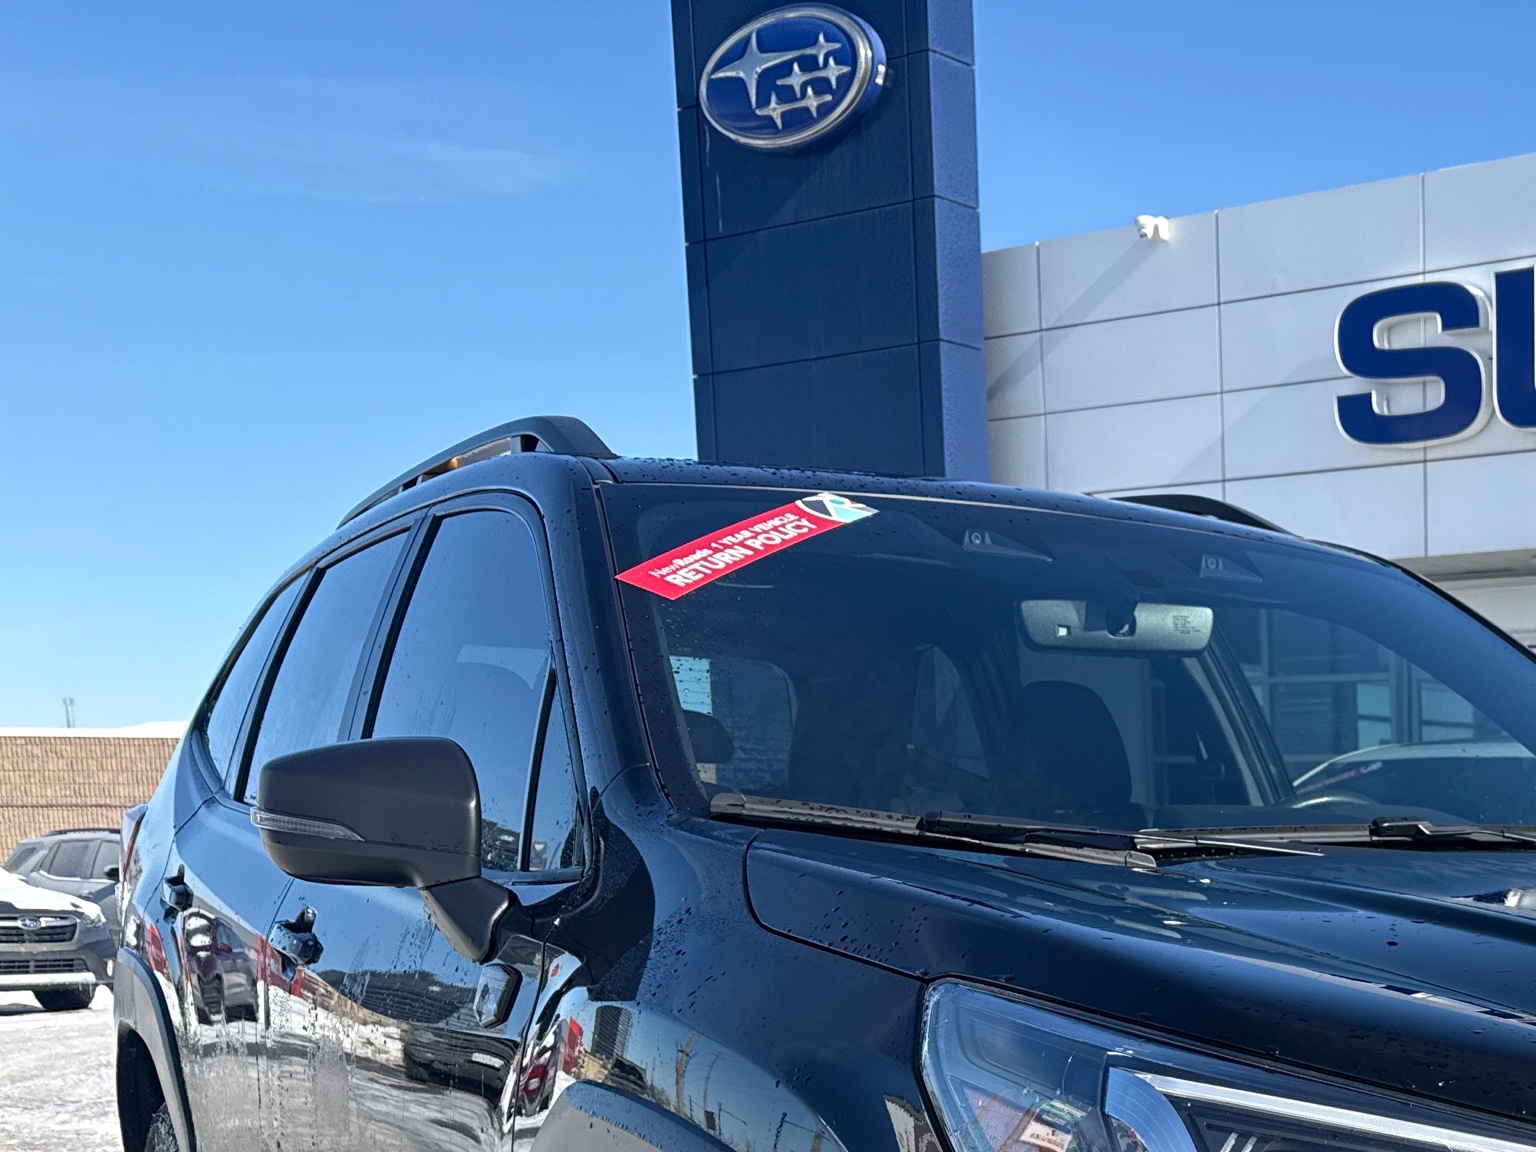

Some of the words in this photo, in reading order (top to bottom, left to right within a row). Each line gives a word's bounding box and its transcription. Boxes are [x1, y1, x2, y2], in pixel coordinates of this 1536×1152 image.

[663, 545, 754, 587] RETURN
[744, 518, 817, 550] POLICY
[717, 529, 754, 545] YEAR
[748, 512, 800, 533] VEHICLE
